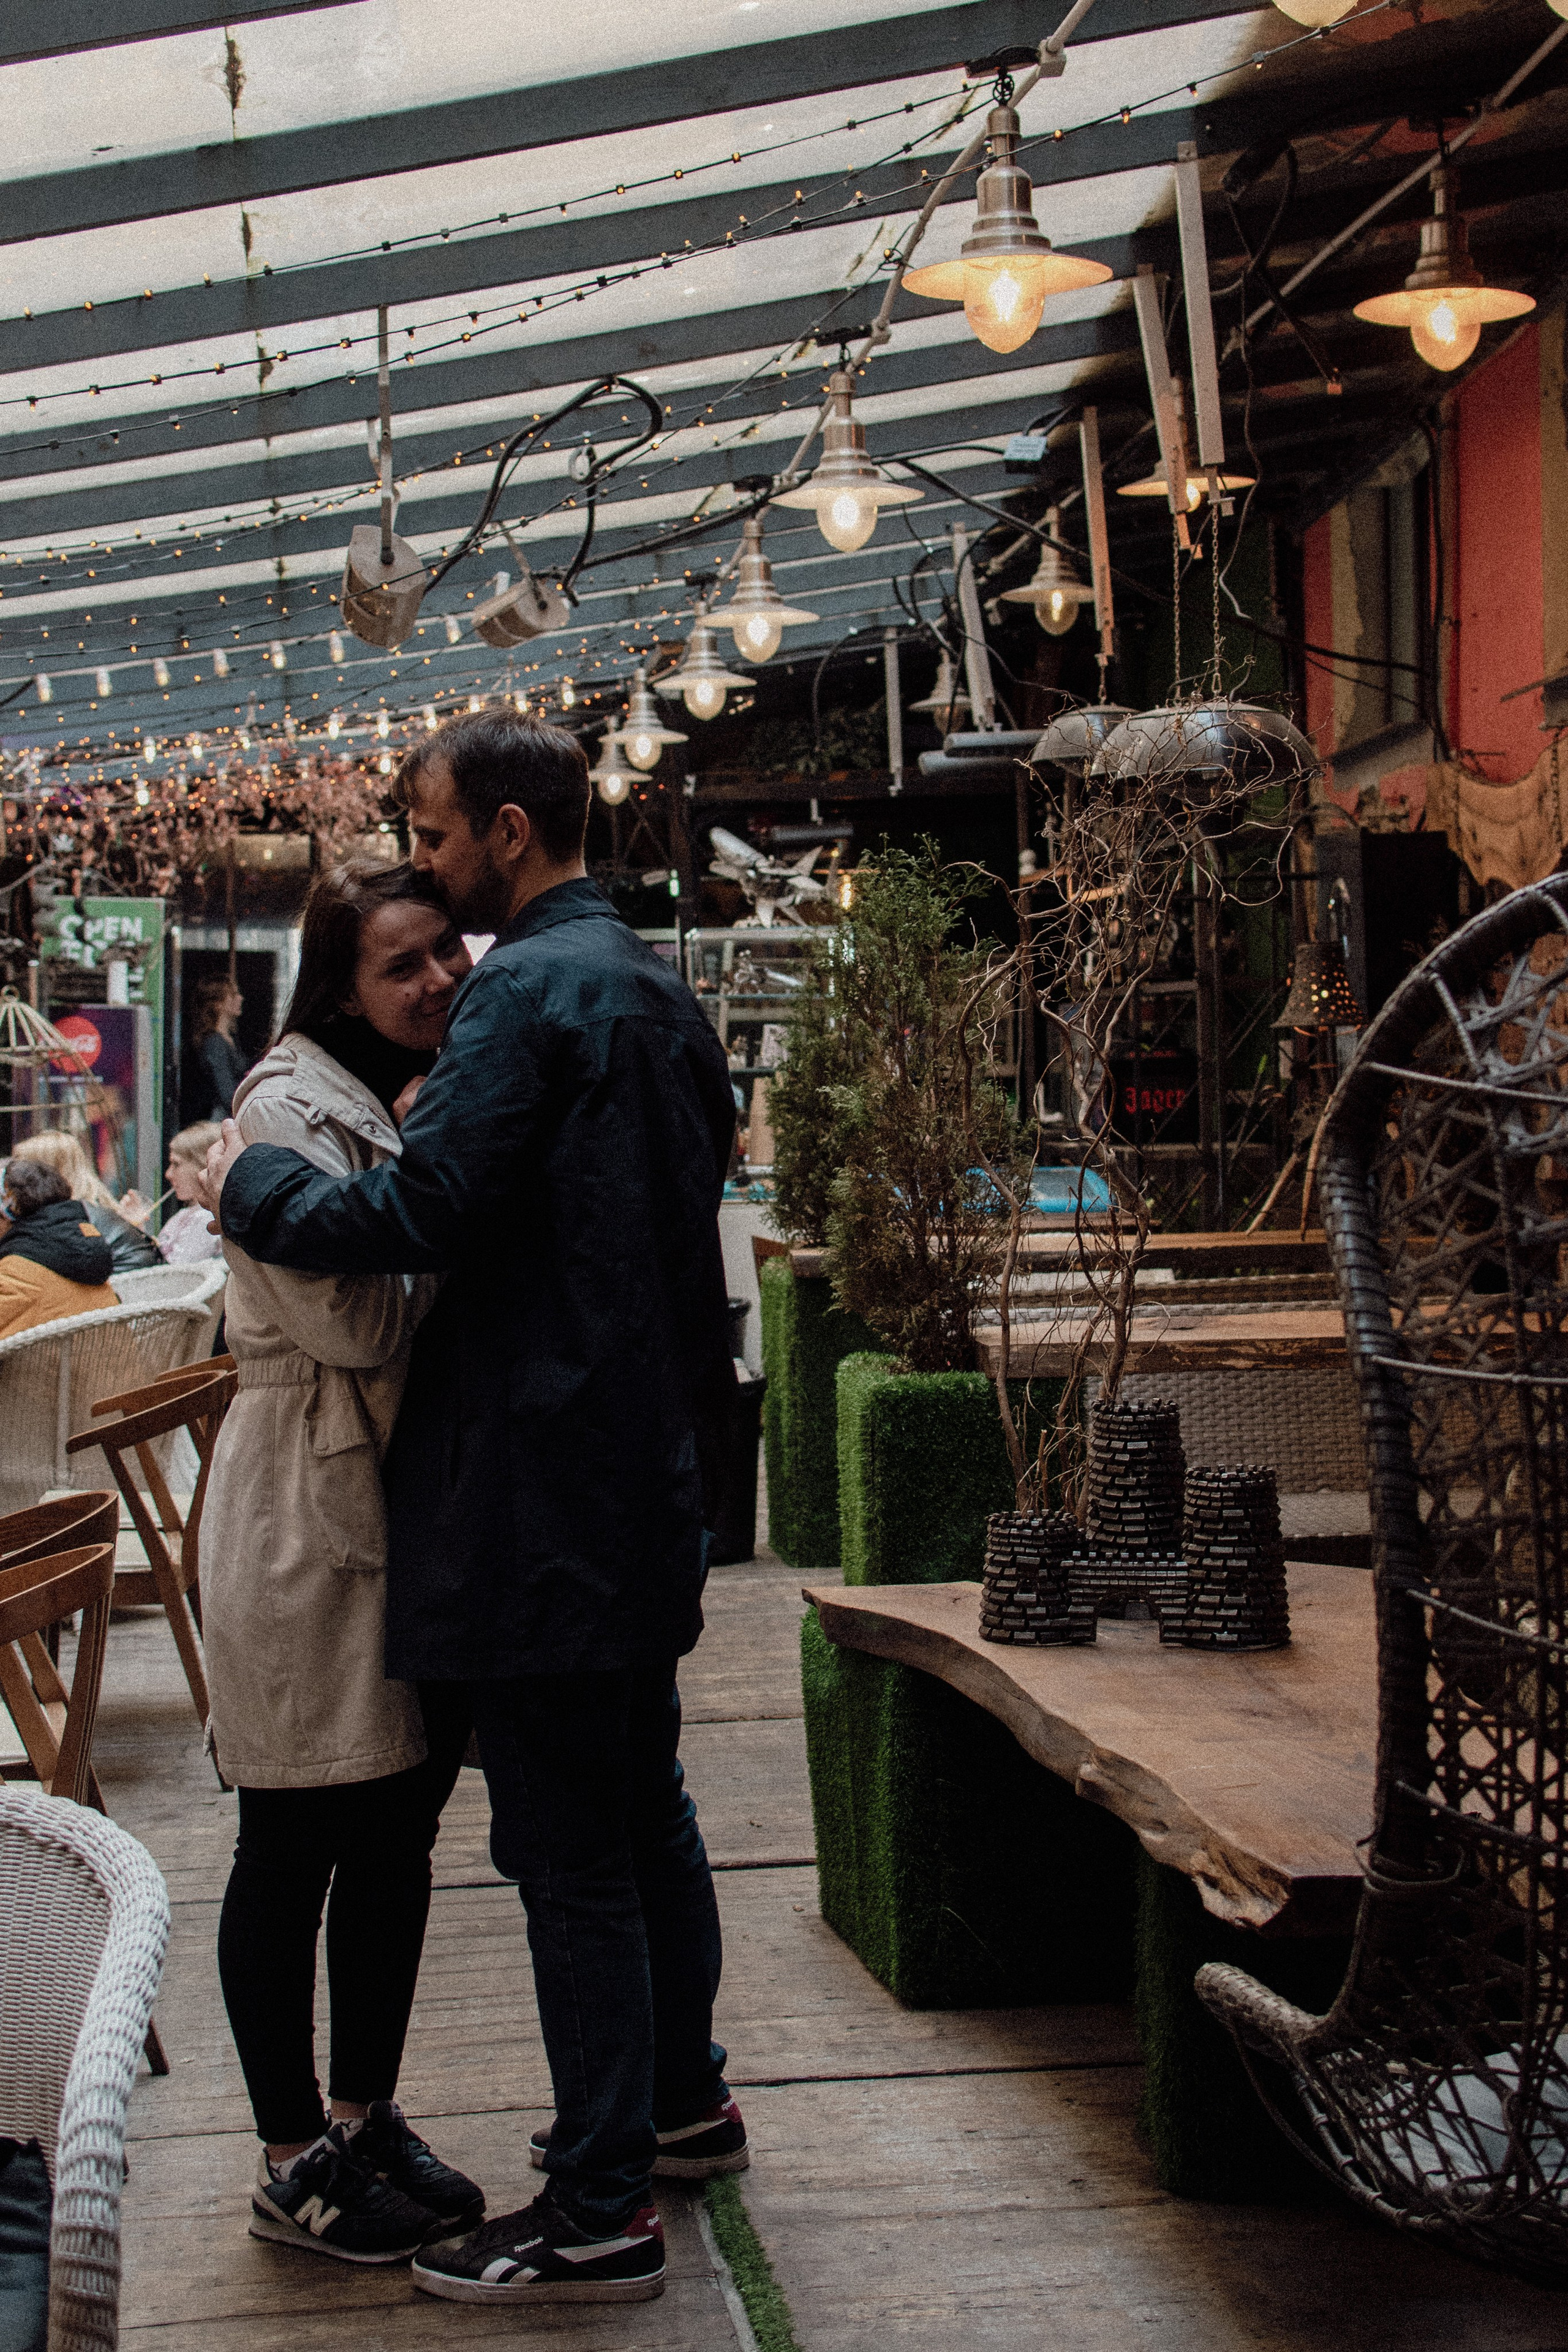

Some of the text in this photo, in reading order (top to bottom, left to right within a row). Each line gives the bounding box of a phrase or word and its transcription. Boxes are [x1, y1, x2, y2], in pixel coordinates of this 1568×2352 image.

[60, 915, 143, 941] OPEN
[293, 2193, 341, 2236] N
[514, 2236, 544, 2252] Reebok
